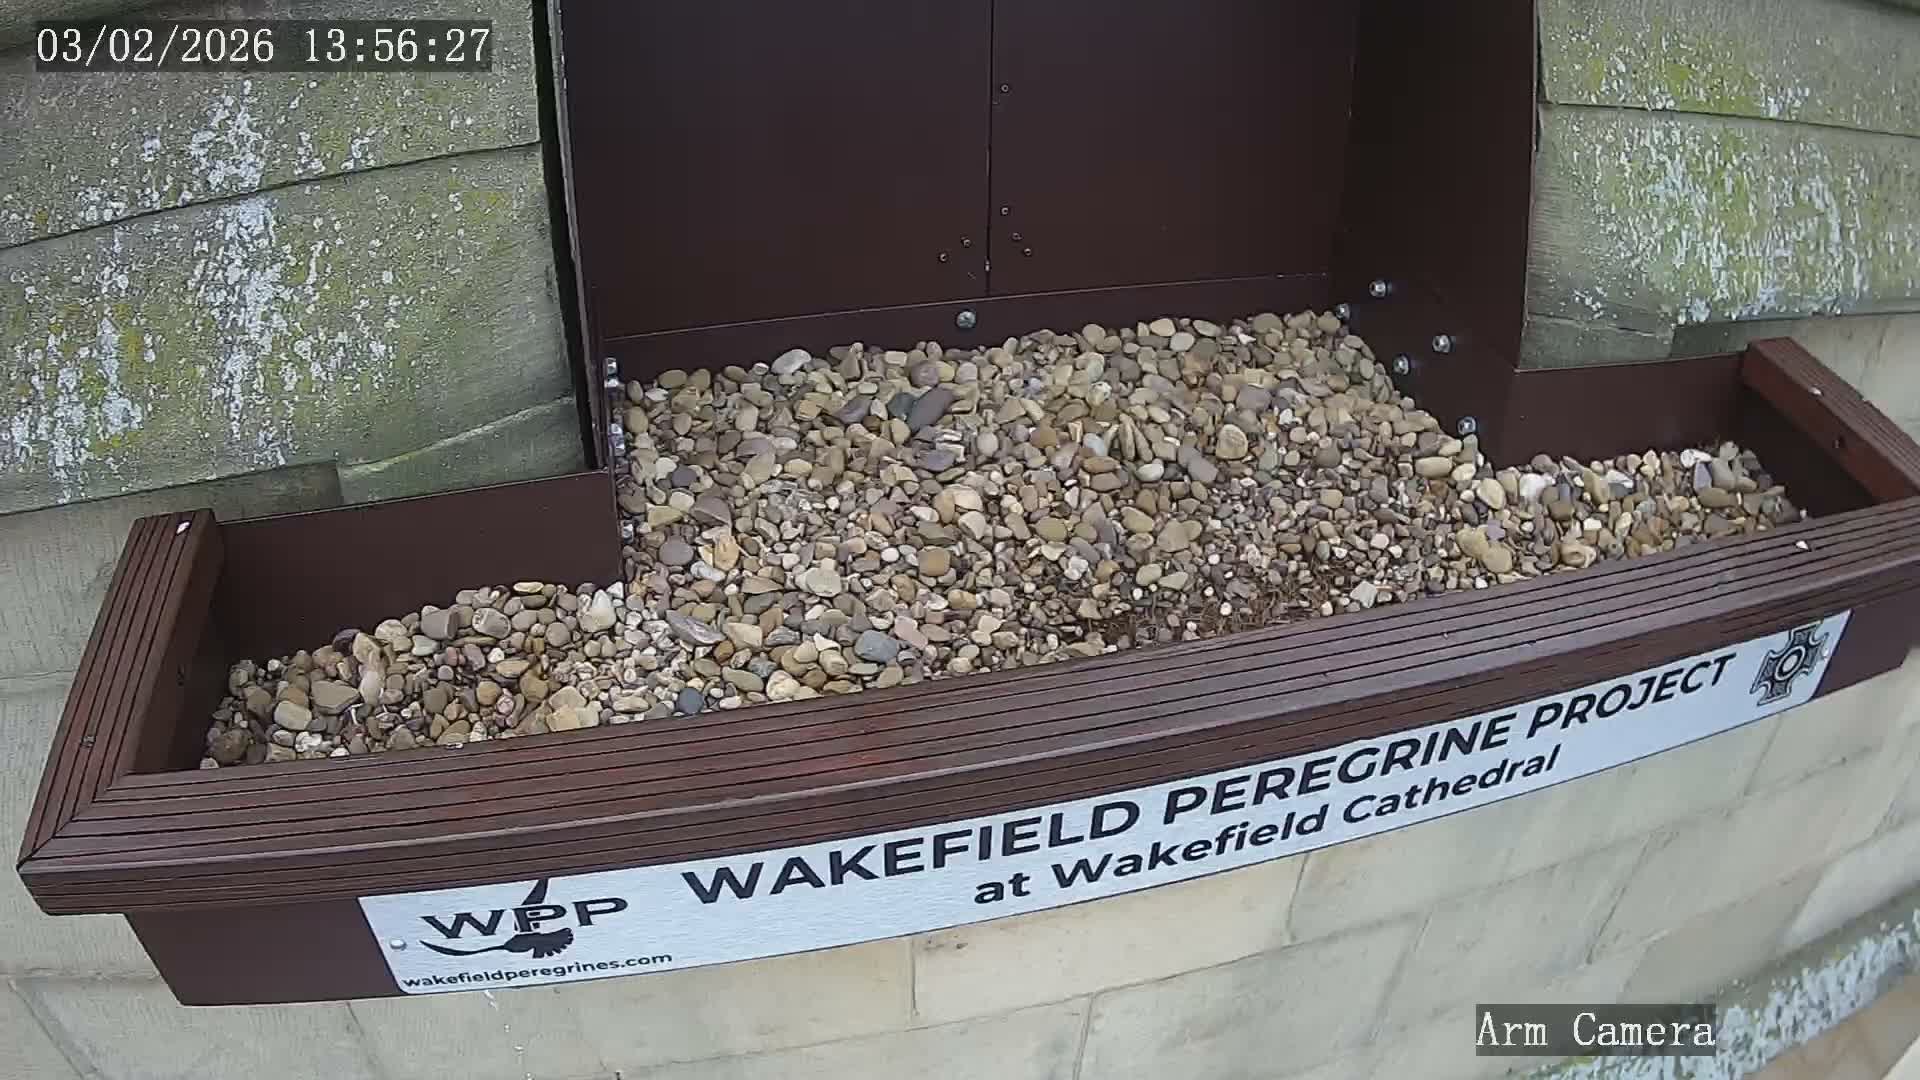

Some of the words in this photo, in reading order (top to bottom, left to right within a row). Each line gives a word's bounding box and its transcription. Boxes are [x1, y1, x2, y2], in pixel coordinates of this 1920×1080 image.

[682, 800, 1140, 904] WAKEFIELD
[1164, 712, 1516, 825] PEREGRINE
[1526, 652, 1737, 738] PROJECT
[973, 872, 1031, 904] at
[1051, 805, 1328, 889] Wakefield
[1342, 744, 1560, 824] Cathedral
[420, 896, 629, 939] WPP
[403, 953, 673, 988] wakefieldperegrines.com
